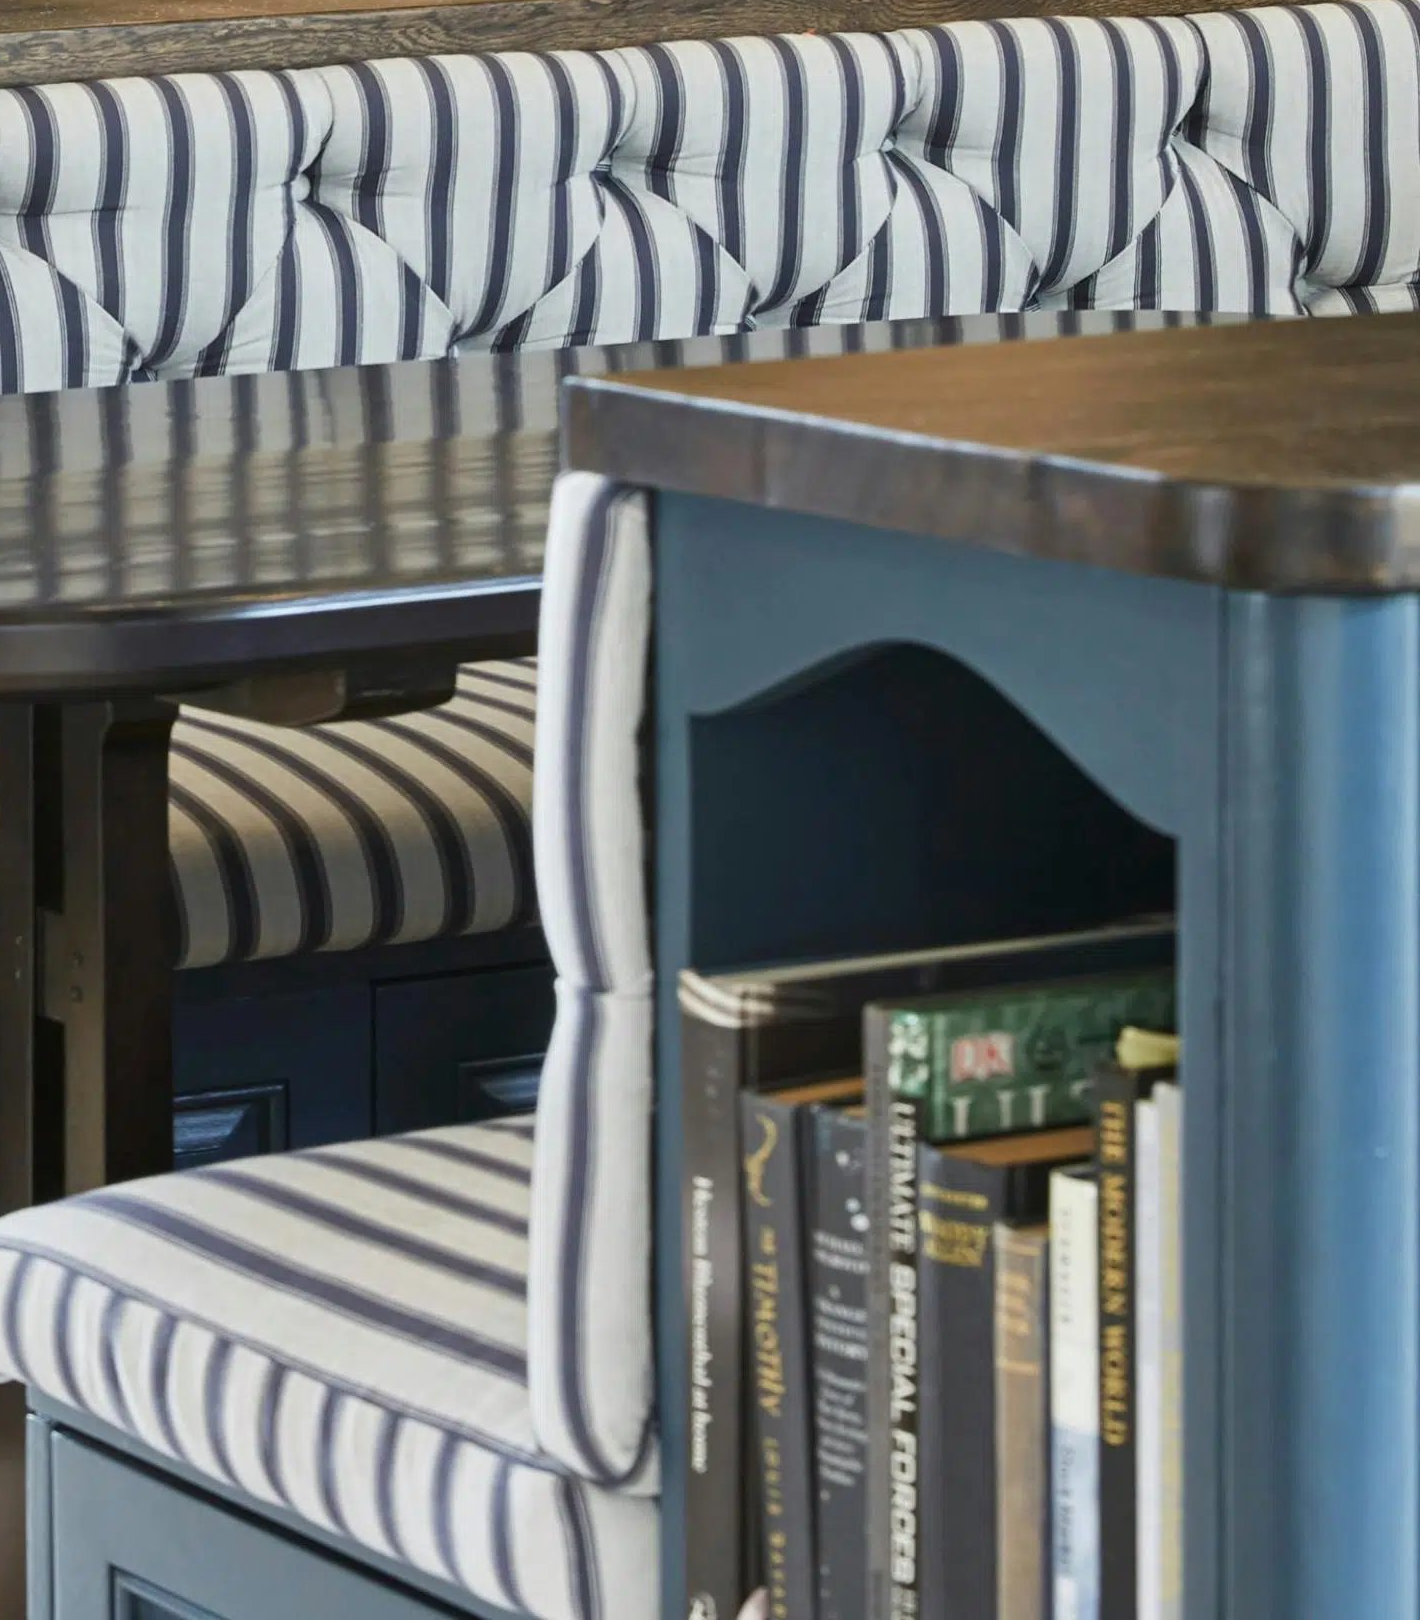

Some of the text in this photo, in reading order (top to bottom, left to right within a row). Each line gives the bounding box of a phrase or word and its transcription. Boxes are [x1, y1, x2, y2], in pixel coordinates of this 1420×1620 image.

[889, 1100, 916, 1253] ULTIMATE
[751, 1262, 786, 1418] TIMOTHY
[889, 1260, 917, 1422] SPECIAL
[1101, 1100, 1128, 1446] THE MODERN WORLD
[889, 1428, 917, 1584] FORCES
